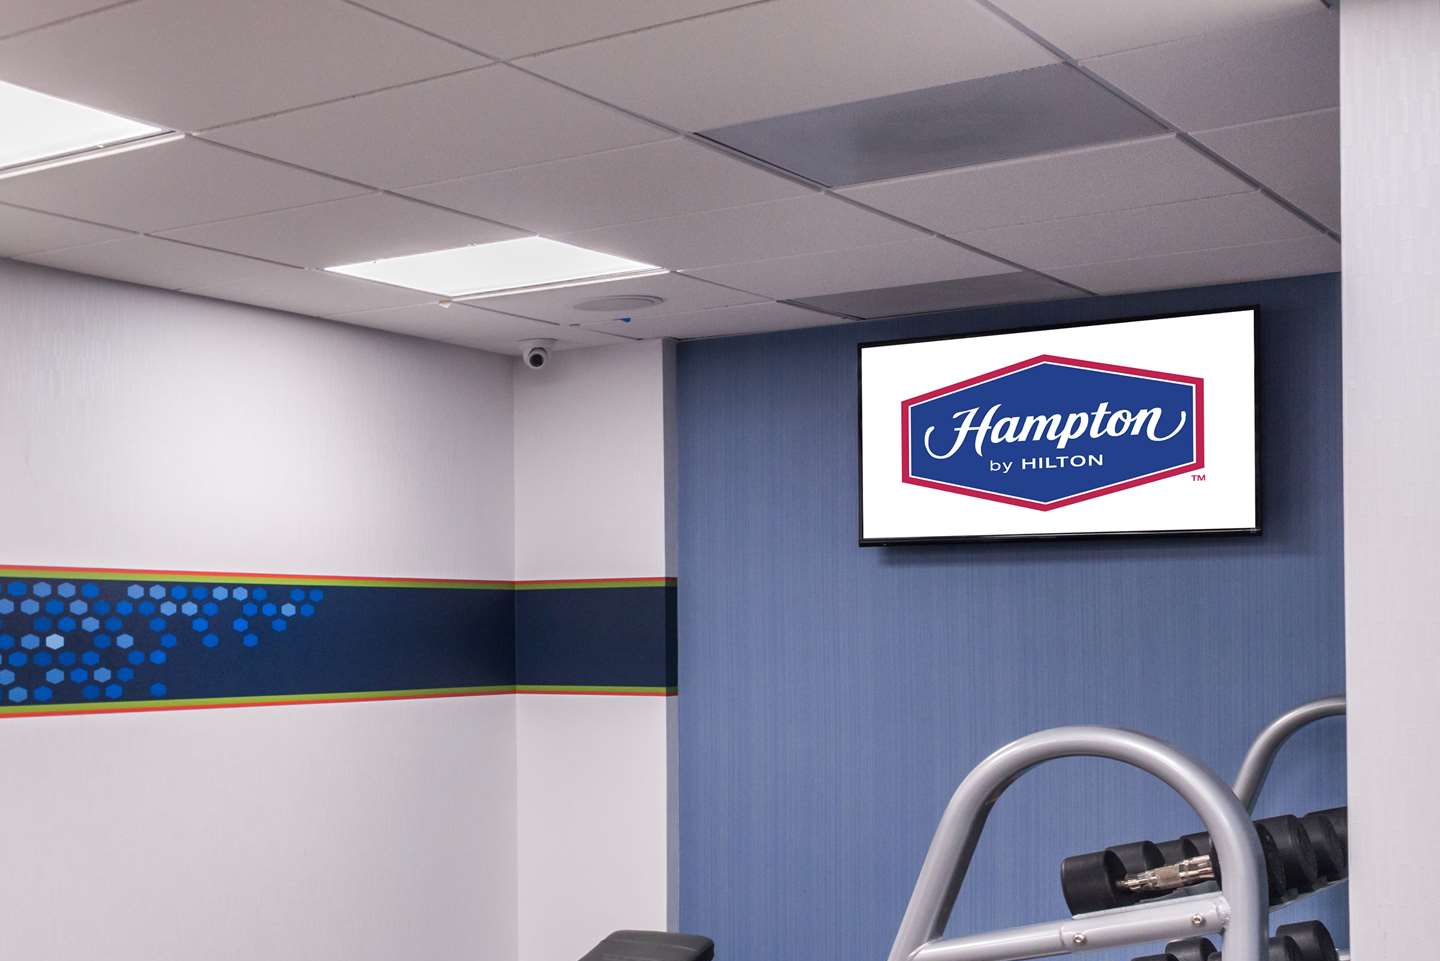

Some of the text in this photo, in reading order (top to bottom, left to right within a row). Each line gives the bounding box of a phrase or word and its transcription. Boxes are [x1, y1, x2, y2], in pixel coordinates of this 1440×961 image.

[924, 401, 1187, 459] Hampton
[989, 454, 1104, 474] by HILTON
